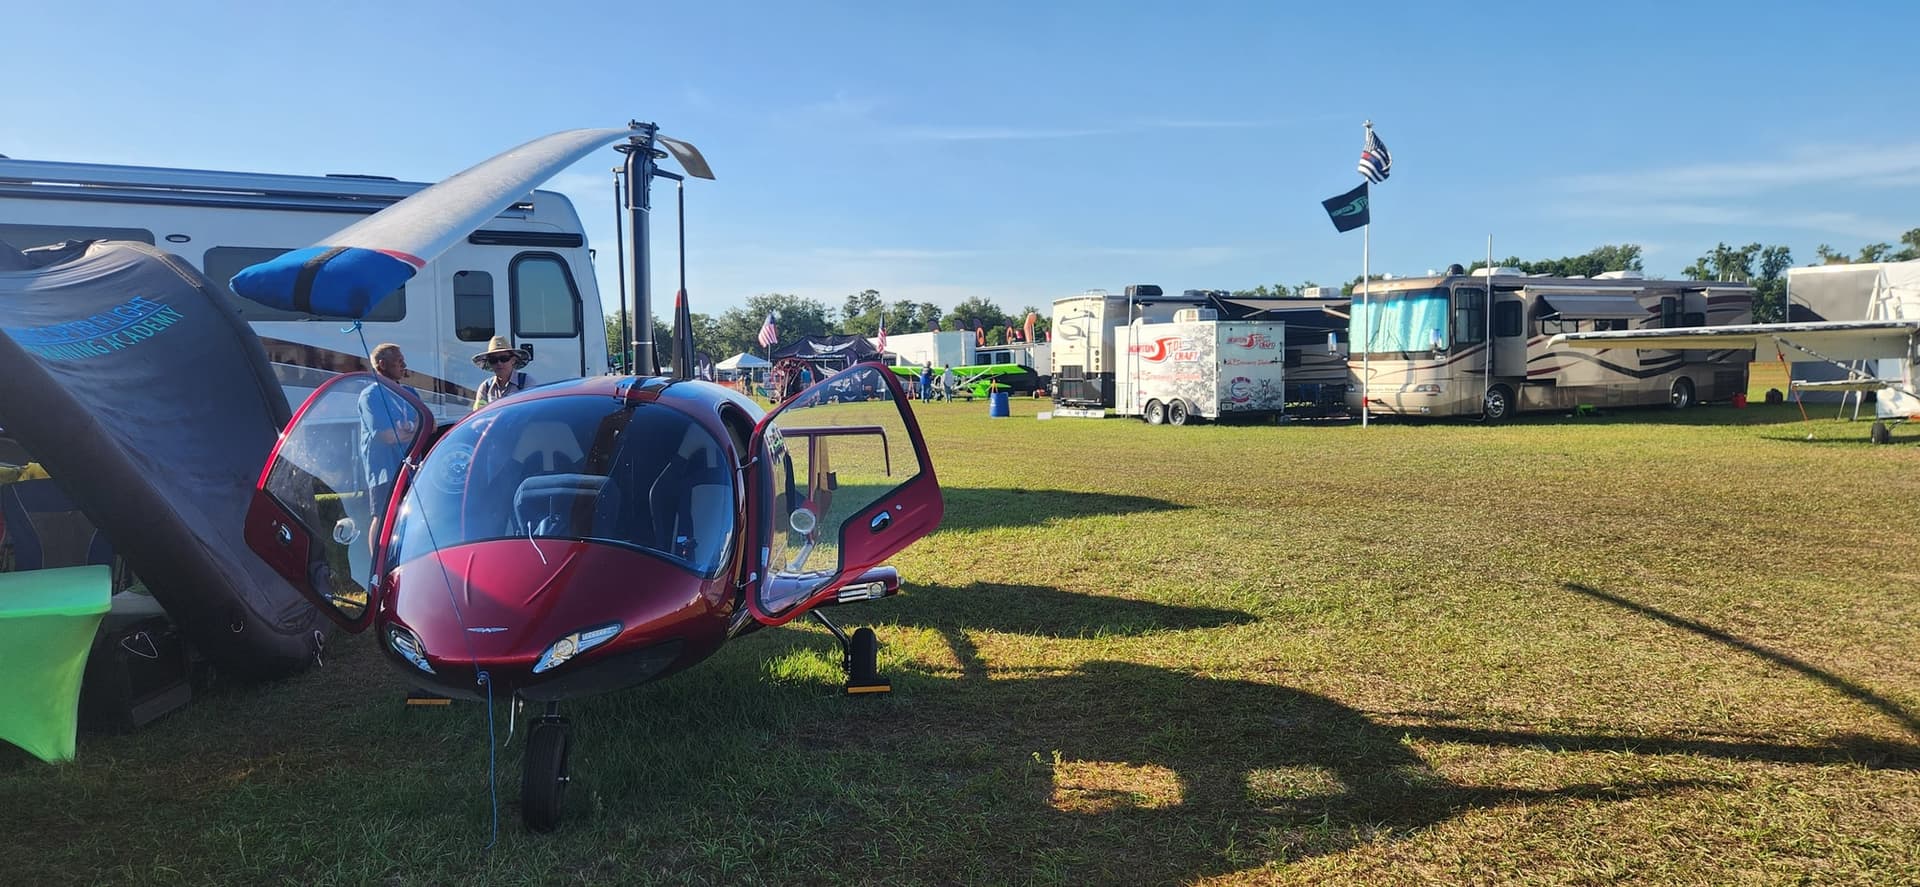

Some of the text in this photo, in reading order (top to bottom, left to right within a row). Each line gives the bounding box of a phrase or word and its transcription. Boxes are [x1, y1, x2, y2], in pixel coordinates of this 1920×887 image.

[88, 295, 160, 331] FLIGHT
[105, 306, 185, 351] ACADEMY
[1174, 351, 1199, 361] CRAFT
